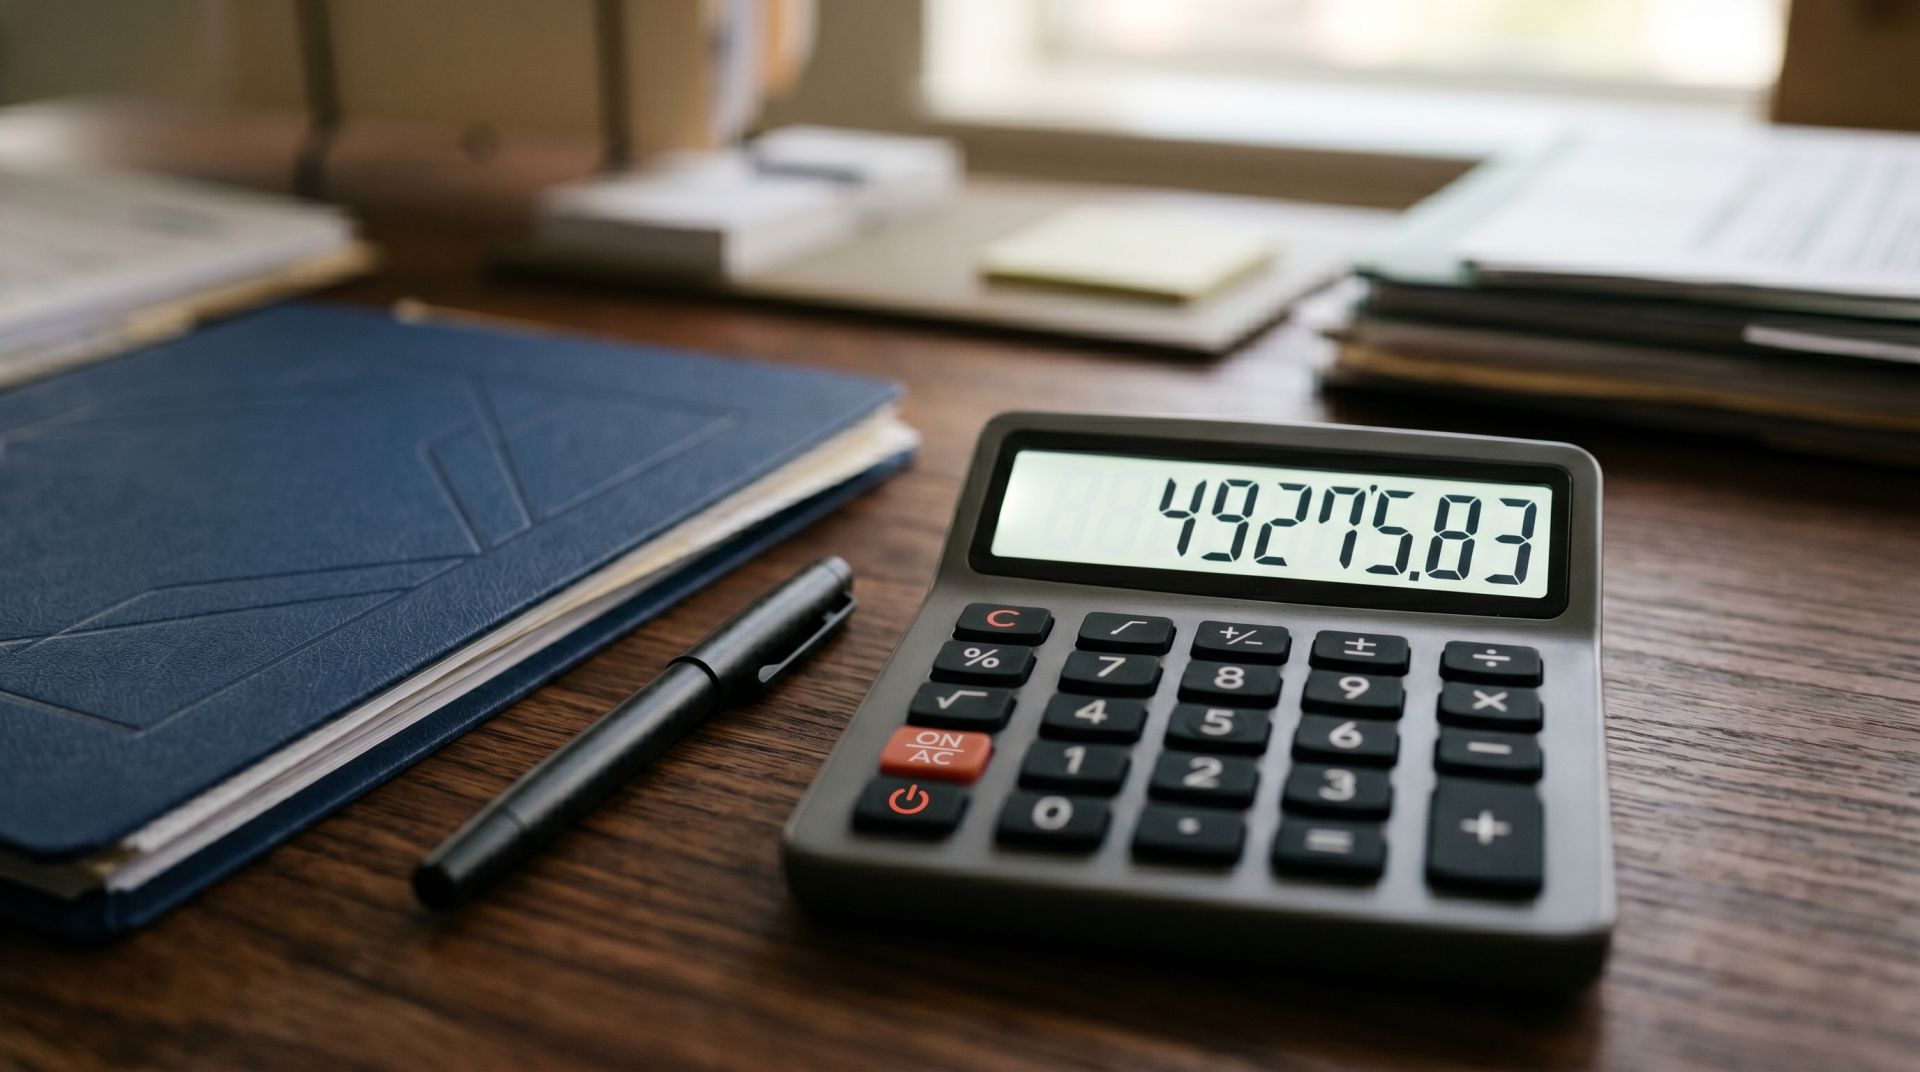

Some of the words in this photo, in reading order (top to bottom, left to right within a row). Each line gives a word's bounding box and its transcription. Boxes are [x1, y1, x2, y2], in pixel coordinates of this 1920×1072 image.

[986, 609, 1021, 627] C
[963, 647, 1000, 669] %
[1098, 655, 1126, 678] 7
[1214, 666, 1245, 689] 8
[1338, 676, 1370, 699] 9
[1075, 699, 1108, 724] 4
[1200, 709, 1234, 736] 5
[915, 731, 963, 748] ON
[1328, 721, 1363, 749] 6
[908, 749, 954, 766] AC
[1065, 746, 1086, 775] 1
[1183, 756, 1223, 789] 2
[1318, 769, 1357, 801] 3
[1031, 796, 1074, 831] 0
